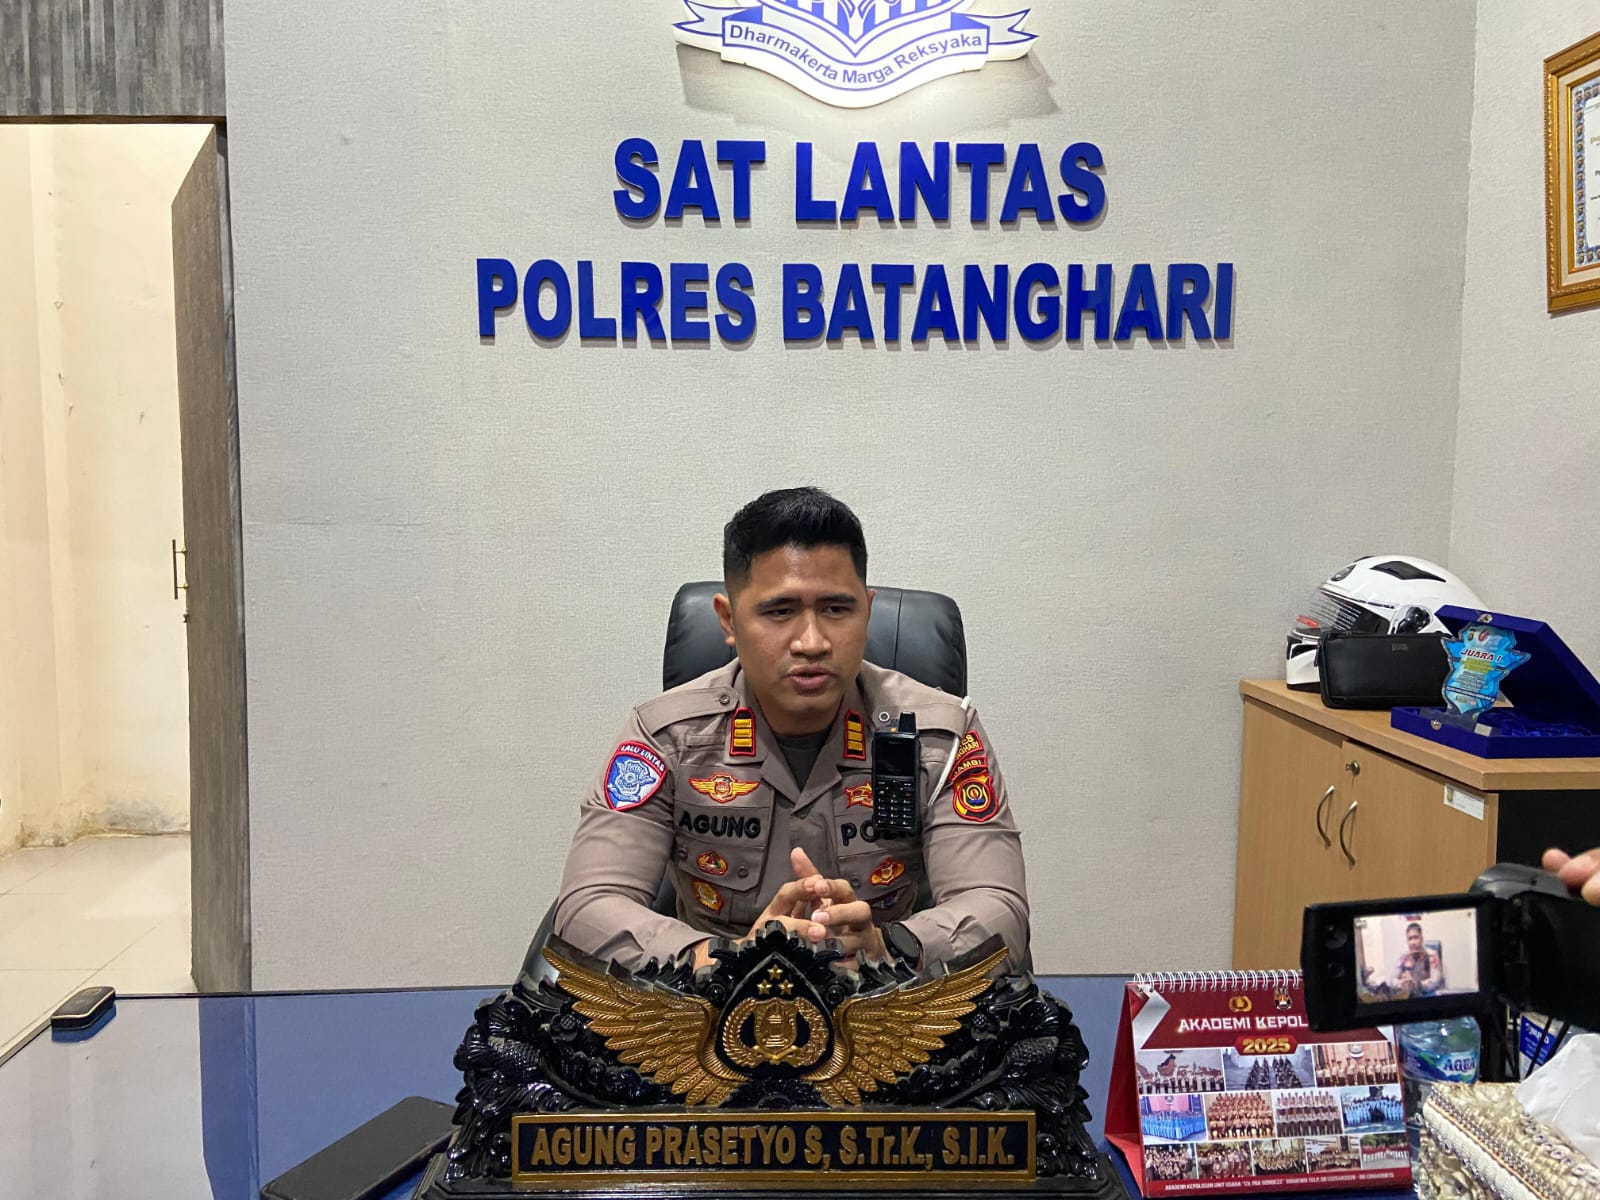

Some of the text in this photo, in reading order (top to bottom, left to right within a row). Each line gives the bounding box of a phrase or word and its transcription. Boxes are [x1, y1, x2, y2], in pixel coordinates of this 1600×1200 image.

[729, 24, 983, 84] Dharmakerta Marga Reksyaka
[613, 137, 1105, 223] SAT LANTAS
[476, 258, 1234, 342] POLRES BATANGHARI
[1461, 648, 1494, 661] JUARA
[620, 744, 666, 773] LALU LINTAS
[678, 810, 762, 840] AGUNG
[1177, 1015, 1309, 1033] AKADEMI KEPOL
[1241, 1037, 1292, 1054] 2025
[1443, 1057, 1476, 1073] AQUA
[530, 1125, 637, 1166] AGUNG
[645, 1124, 797, 1166] PRASETYO
[804, 1124, 832, 1172] S,
[941, 1125, 1015, 1166] S.I.K.
